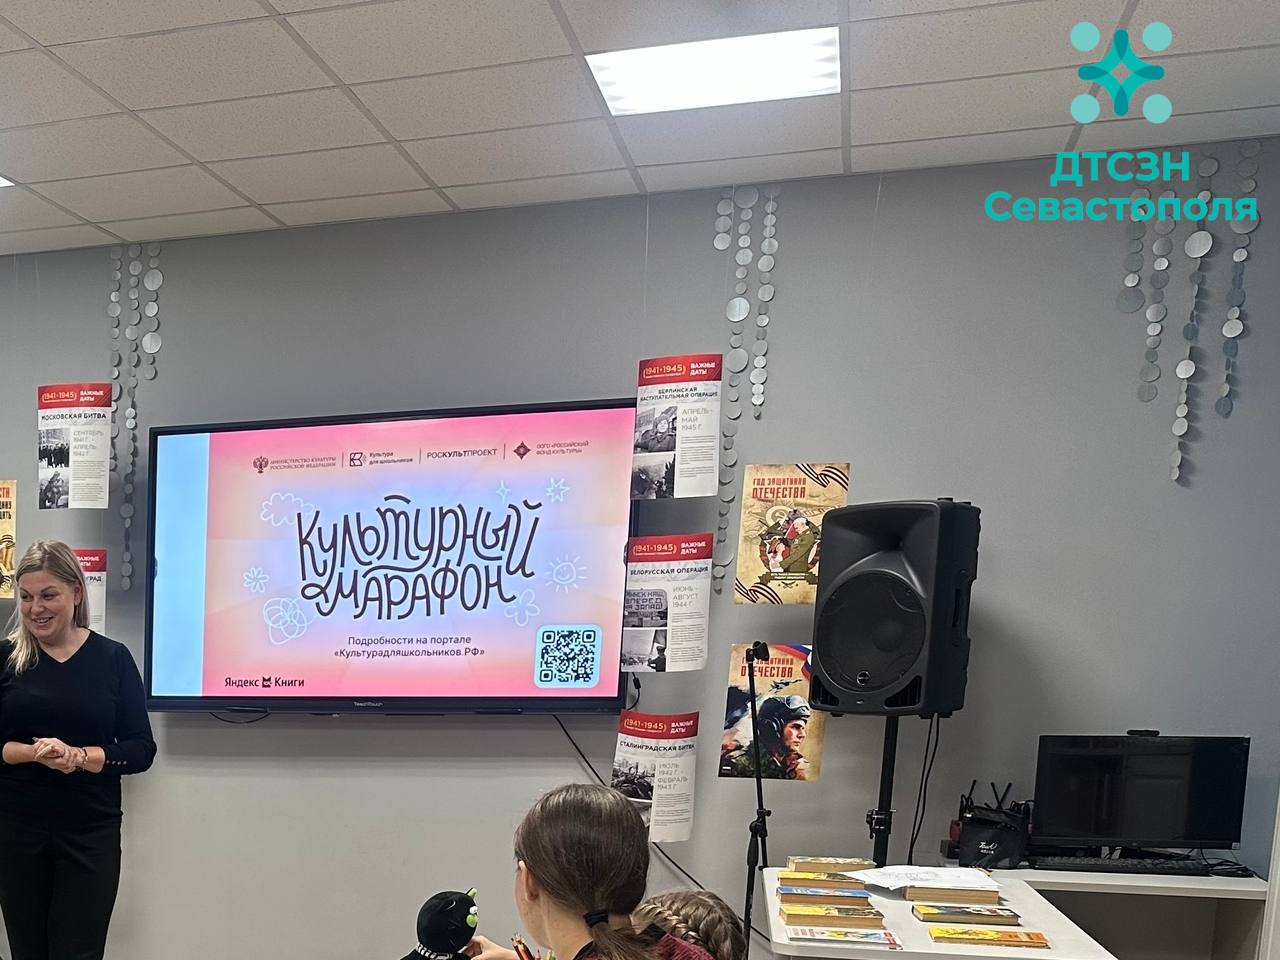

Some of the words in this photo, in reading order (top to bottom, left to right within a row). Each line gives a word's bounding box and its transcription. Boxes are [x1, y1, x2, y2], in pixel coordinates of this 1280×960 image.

[41, 413, 83, 421] МОСКОВСКАЯ
[369, 451, 394, 459] Культура
[427, 448, 497, 459] РОСКУЛЬТПРОЕКТ
[753, 477, 766, 486] ГОД
[767, 477, 807, 486] ЗАЩИТНИКА
[752, 487, 806, 499] ОТЕЧЕСТВА
[630, 568, 675, 576] БЕЛОРУССКАЯ
[676, 566, 709, 574] ОПЕРАЦИЯ
[348, 636, 413, 647] Подробности
[416, 637, 428, 645] на
[430, 636, 472, 647] портале
[334, 647, 485, 659] «Культурадляшкольников.РФ»
[741, 666, 793, 678] ОЕЧЕСТВА
[224, 677, 260, 689] Яндекс
[274, 677, 305, 688] Книги
[620, 740, 677, 752] СТАЛИНГРАДСКАЯ
[678, 743, 695, 751] БИТВА
